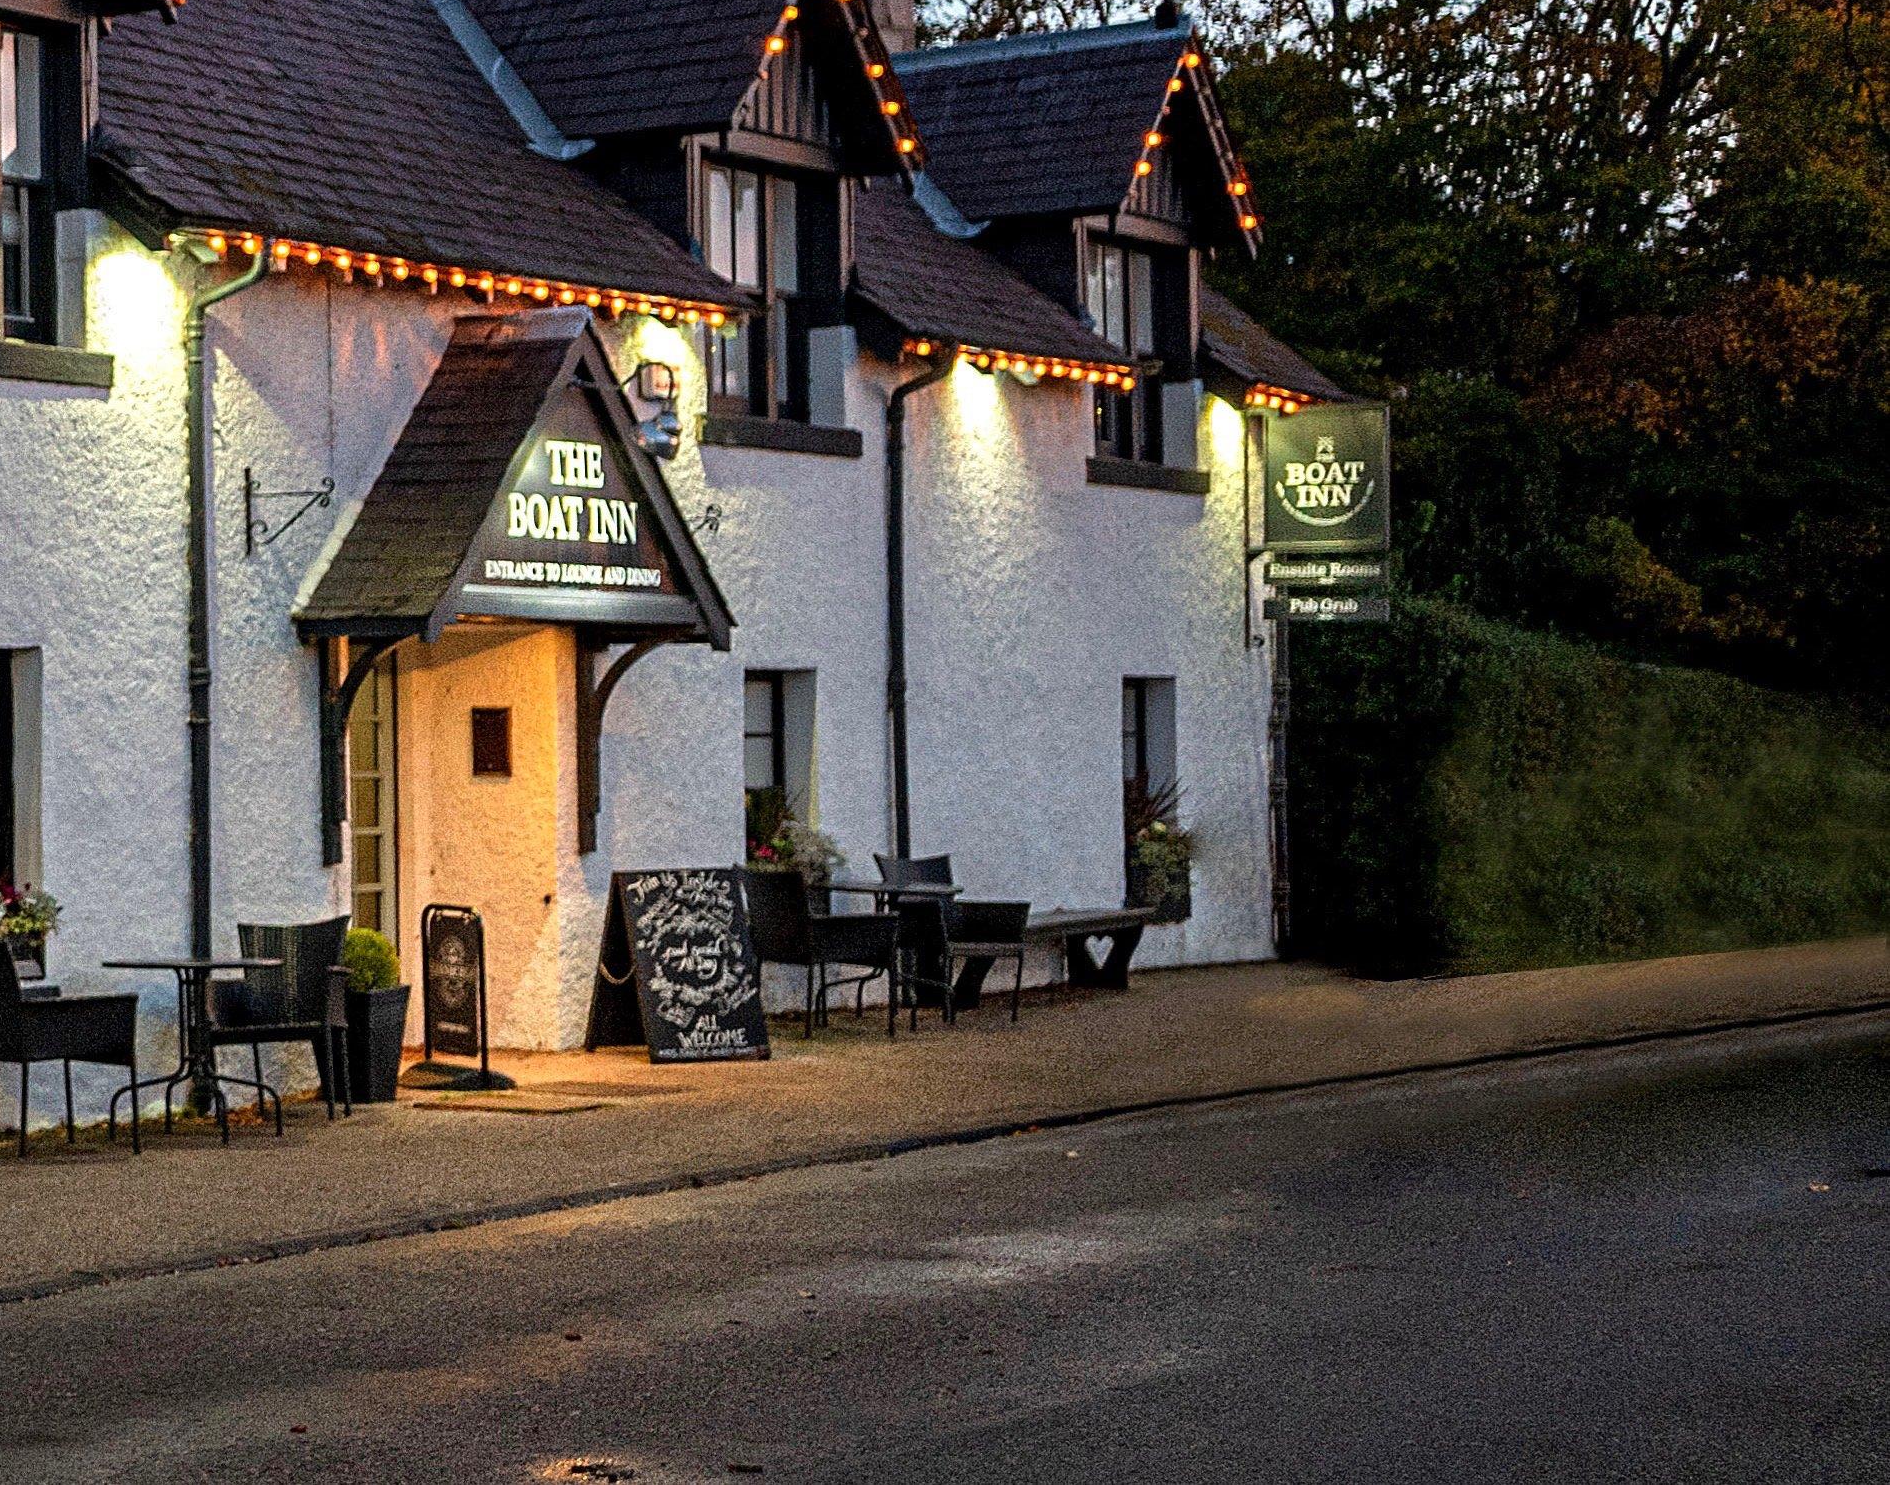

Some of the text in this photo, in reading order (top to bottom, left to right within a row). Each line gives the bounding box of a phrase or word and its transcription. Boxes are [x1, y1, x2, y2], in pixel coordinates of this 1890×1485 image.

[545, 440, 605, 489] THE
[1284, 461, 1365, 486] BOAT
[1296, 484, 1354, 508] INN
[507, 492, 638, 546] BOAT INN
[485, 560, 661, 588] ENTRANCE TO LOUNGE AND DINING
[1270, 562, 1381, 578] Ensuite Rooms
[1289, 598, 1358, 614] Pub Grub
